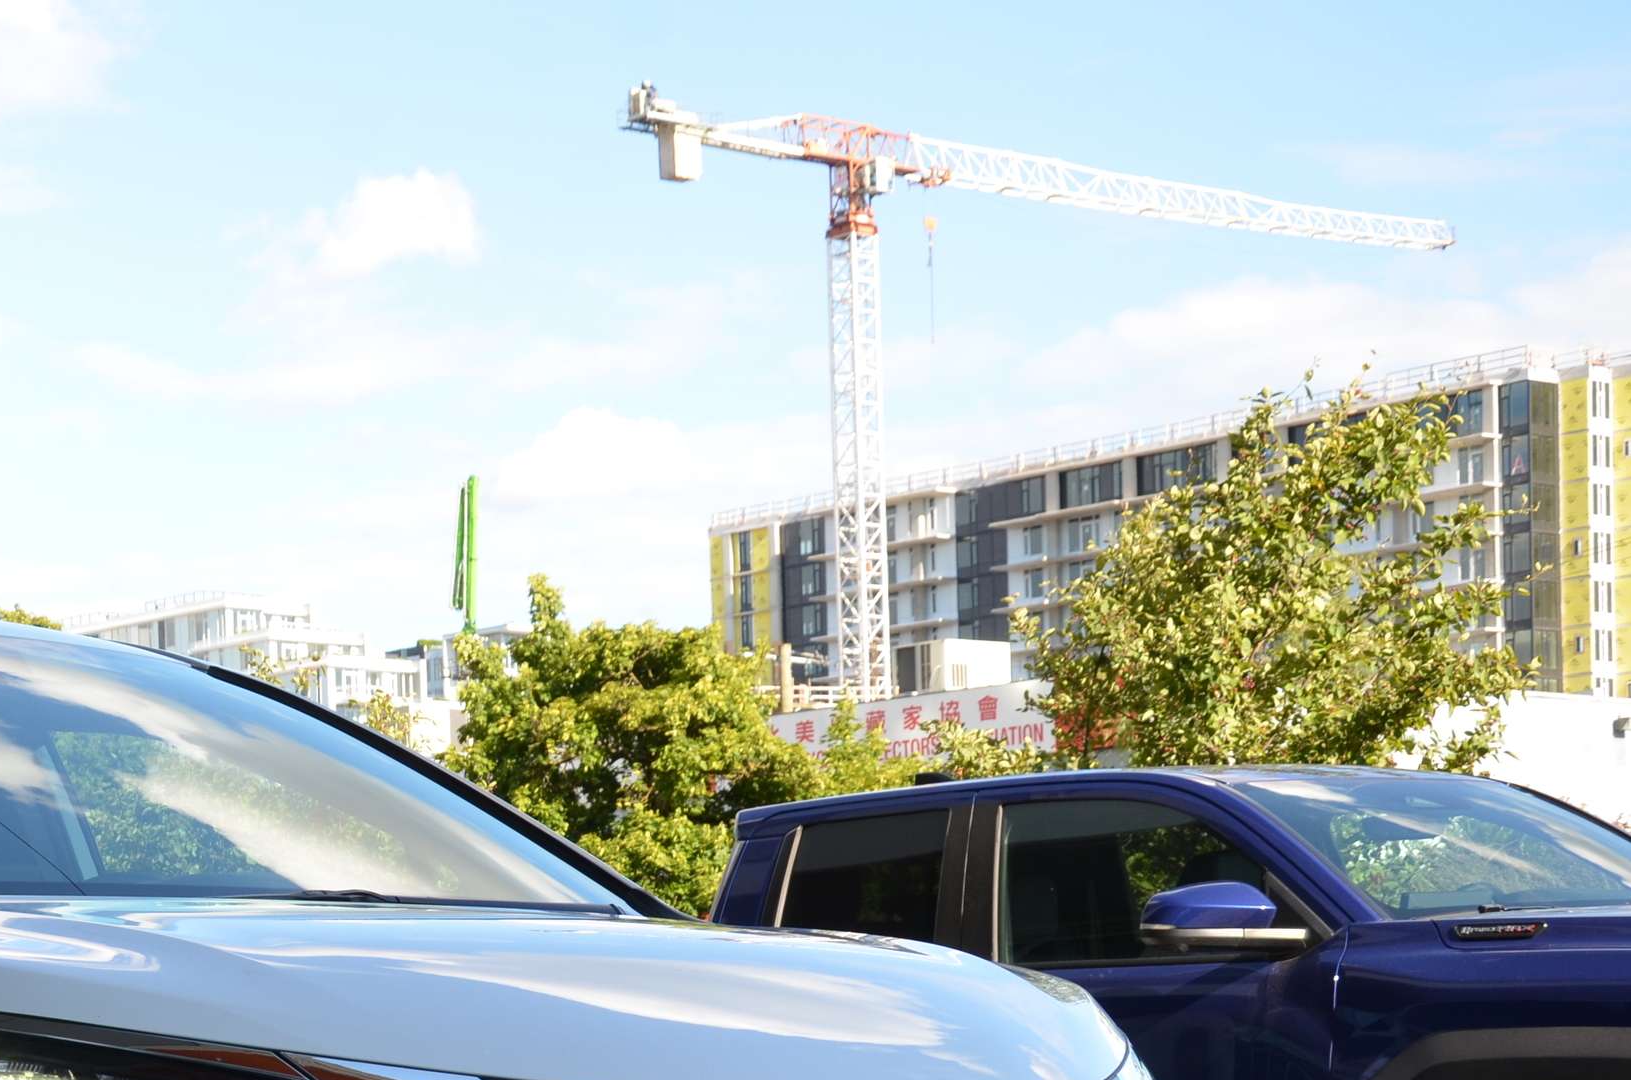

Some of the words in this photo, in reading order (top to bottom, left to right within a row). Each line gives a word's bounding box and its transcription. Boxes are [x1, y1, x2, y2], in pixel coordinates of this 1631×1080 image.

[770, 695, 999, 743] 美藏家協會
[883, 735, 941, 761] ECTORS
